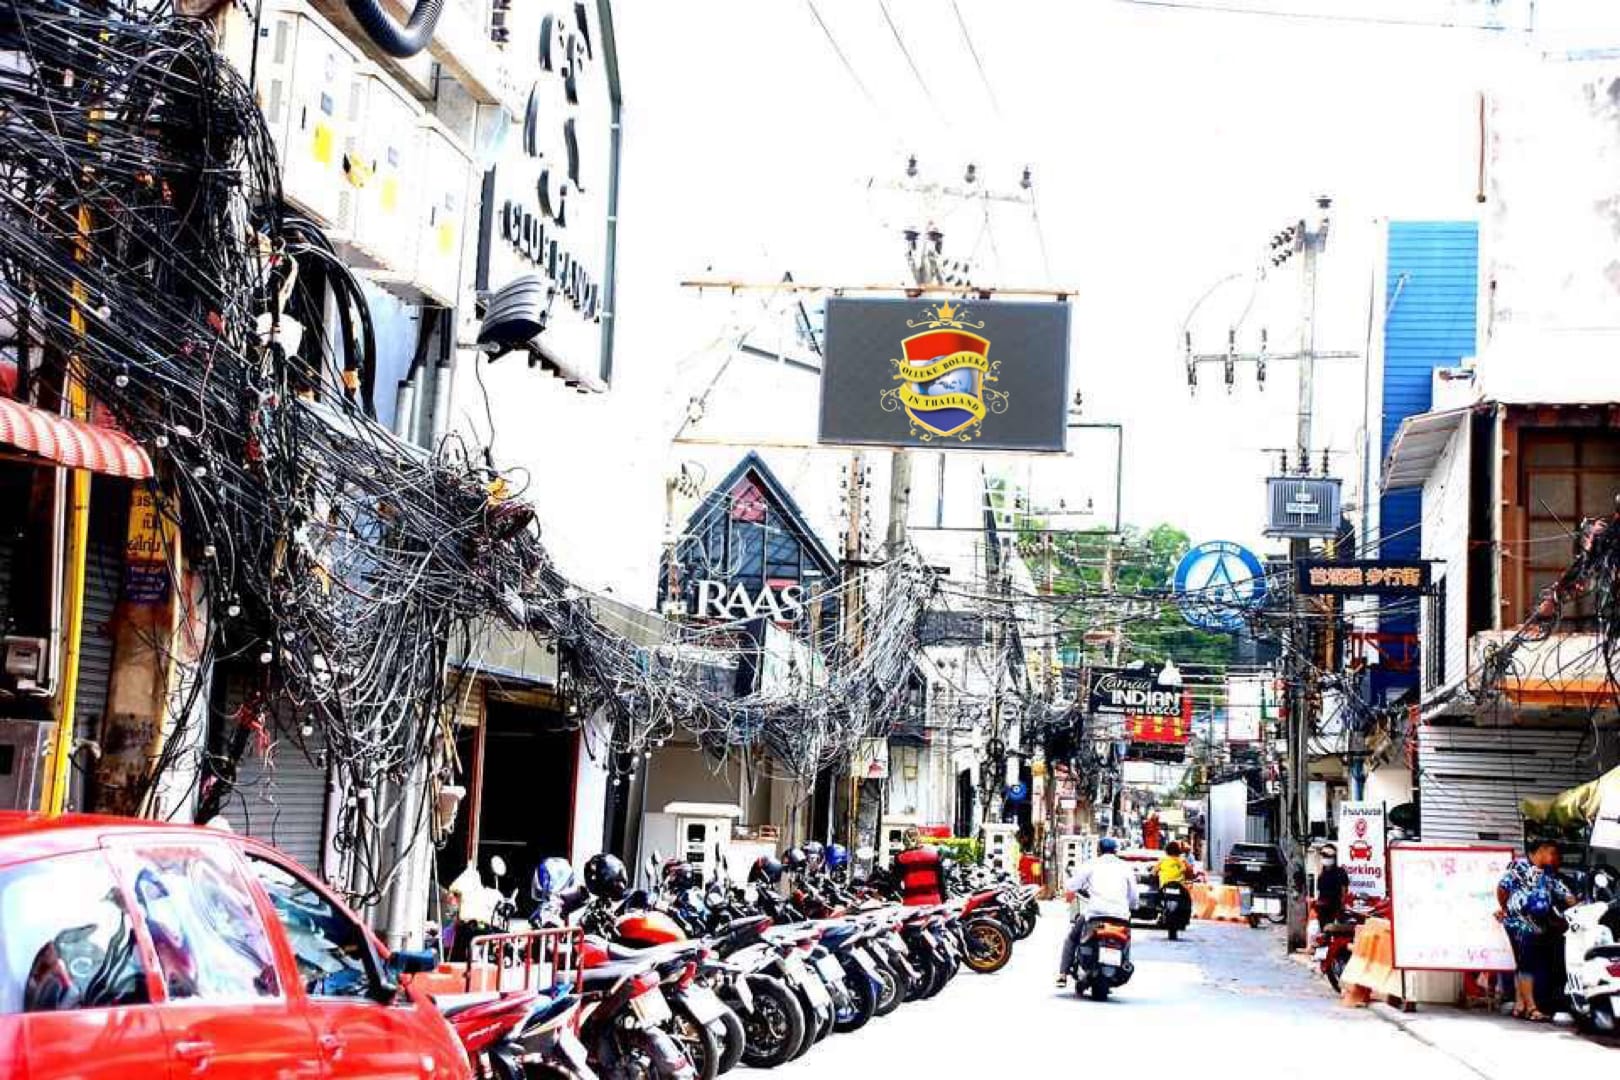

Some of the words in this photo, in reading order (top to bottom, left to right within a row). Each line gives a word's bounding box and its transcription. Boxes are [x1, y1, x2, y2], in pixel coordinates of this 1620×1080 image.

[902, 366, 938, 377] OLLEKE
[943, 356, 988, 369] BOLLEKE
[908, 396, 919, 405] IN
[925, 396, 979, 411] THAILAND
[695, 579, 804, 621] RAAS
[1112, 689, 1181, 710] INDIAN
